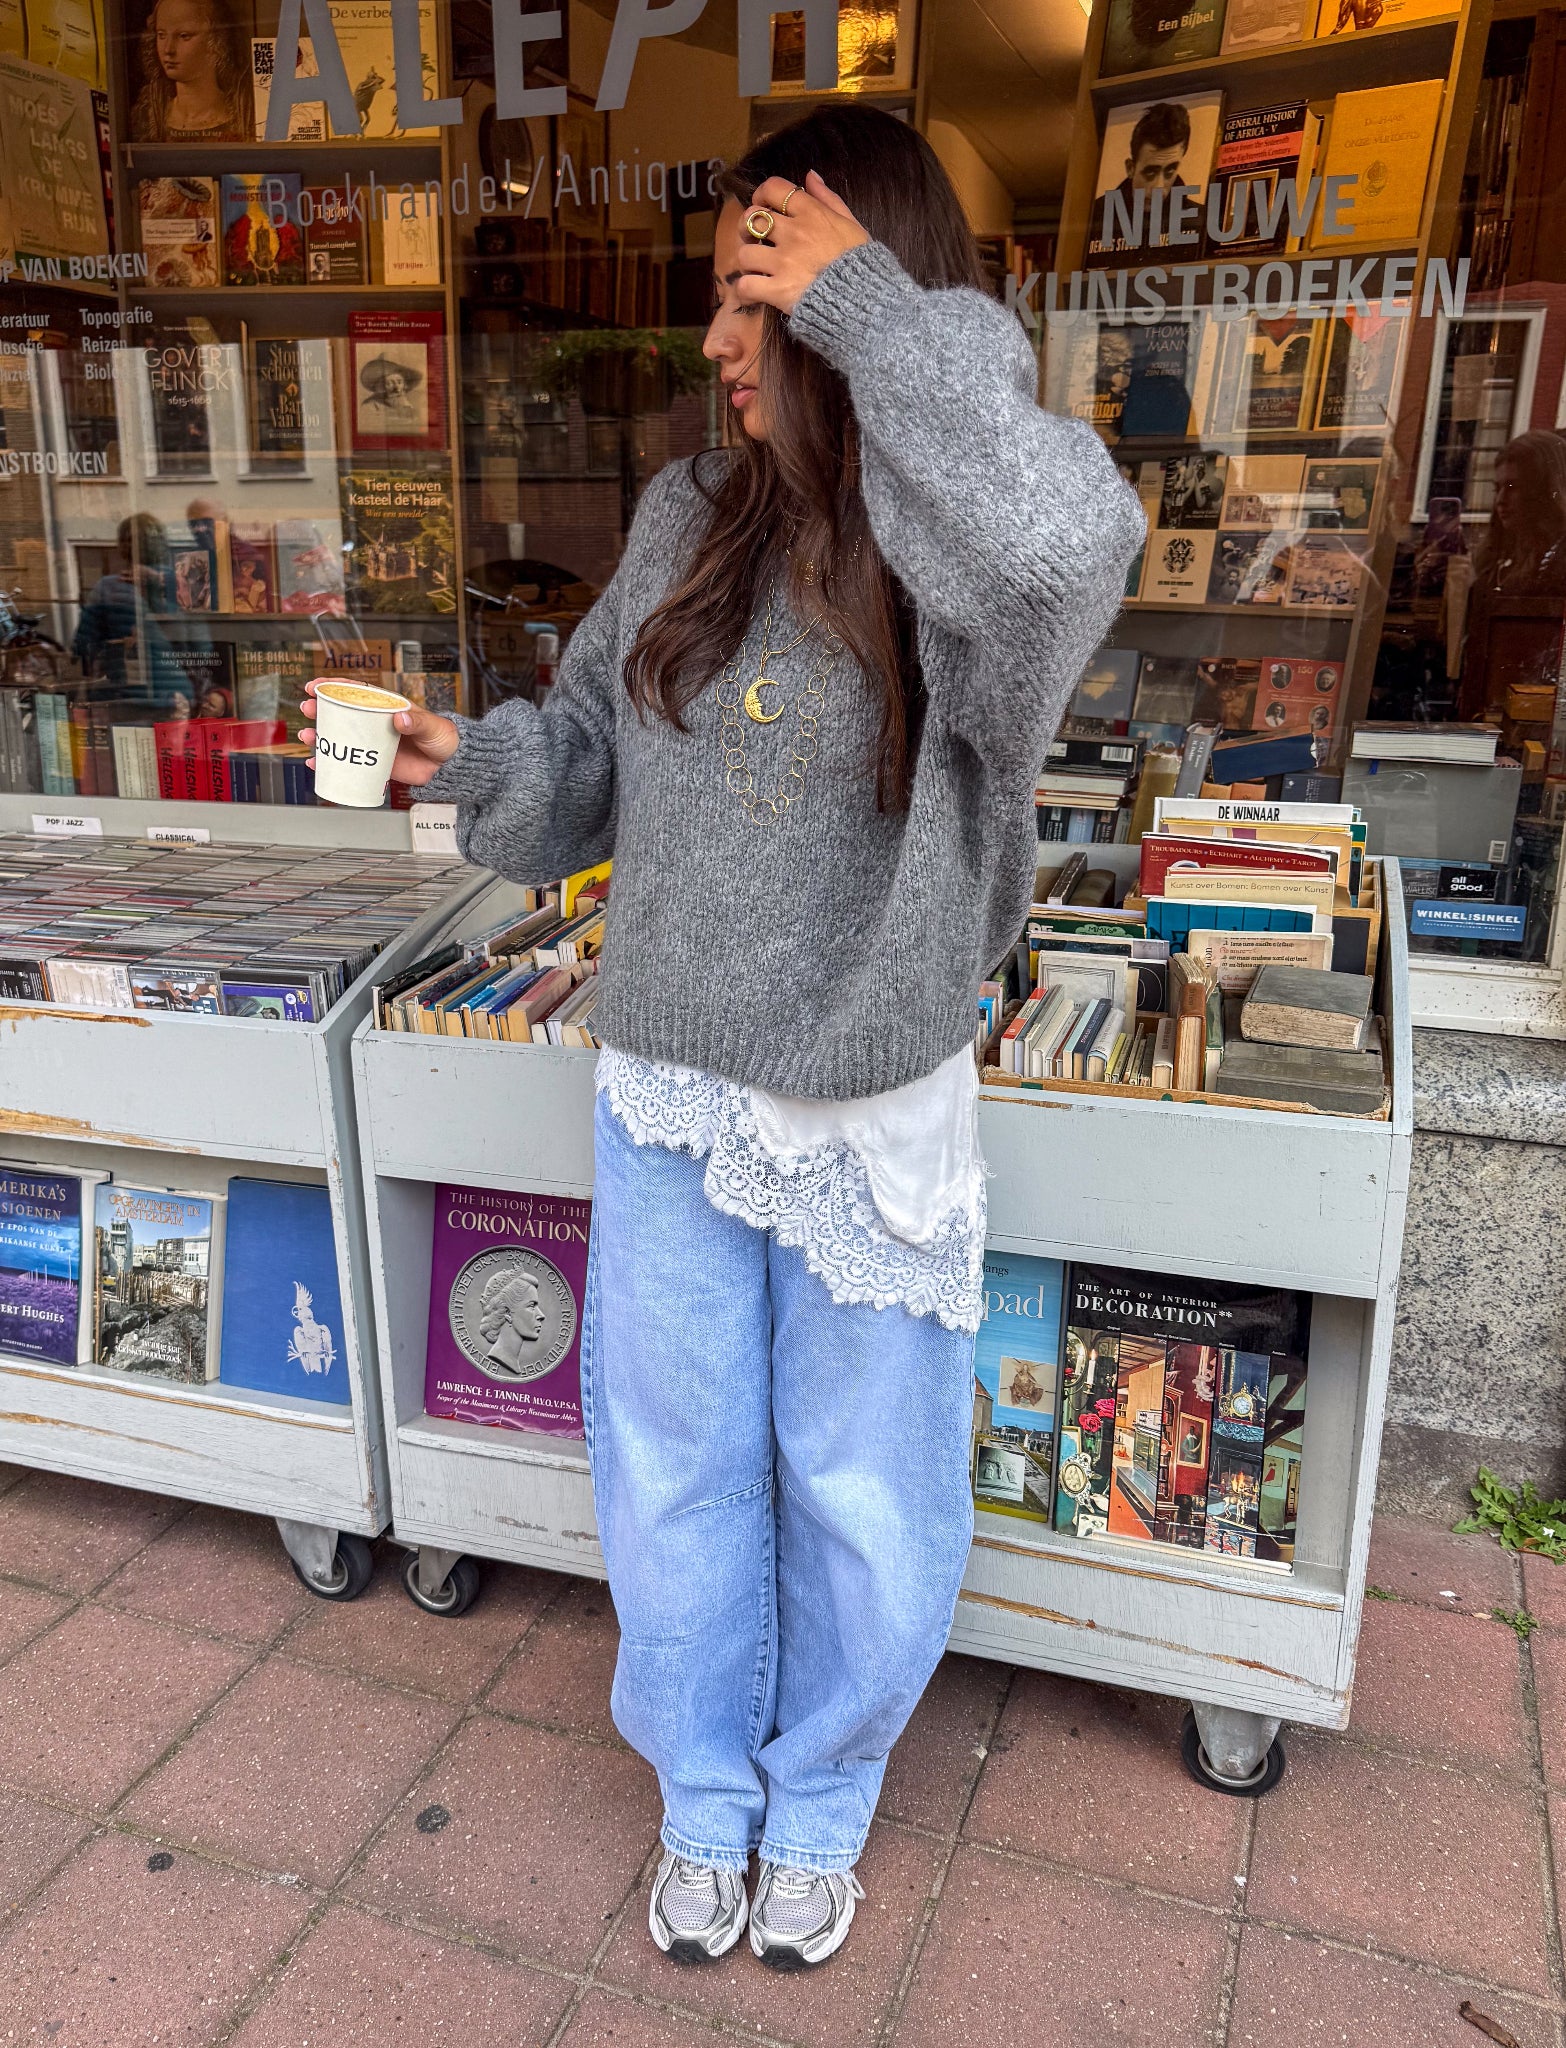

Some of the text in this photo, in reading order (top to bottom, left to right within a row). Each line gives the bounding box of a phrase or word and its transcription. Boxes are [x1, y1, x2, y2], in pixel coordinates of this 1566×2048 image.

[330, 6, 431, 19] De verbers
[1158, 9, 1215, 32] Een Bijbel
[254, 42, 273, 51] THE
[254, 51, 274, 59] BIG
[254, 59, 274, 67] FAT
[254, 67, 273, 75] ONE
[9, 95, 58, 124] MOES
[1226, 109, 1298, 130] GENERAL HISTORY
[1224, 131, 1236, 142] OF
[1236, 126, 1265, 139] AFRICA
[30, 127, 87, 160] LANGS
[1102, 174, 1359, 247] NIEUWE
[20, 257, 62, 282] VAN
[69, 252, 149, 280] BOEKEN
[1006, 257, 1471, 328] KUNSTBOEKEN
[79, 305, 153, 329] Topografie
[1143, 325, 1200, 339] THOMAS
[82, 336, 128, 353] Reizen
[1146, 340, 1191, 353] MANN
[143, 346, 236, 368] GOVERT
[151, 370, 236, 391] FLINCK
[365, 478, 442, 492] Tien eeuwen
[349, 493, 443, 506] Kasteel de Haar
[244, 651, 266, 663] THE
[323, 645, 382, 670] Artusi
[245, 663, 264, 675] THE
[1218, 805, 1280, 821] DE WINNAAR
[66, 818, 84, 826] JAZZ
[415, 822, 451, 830] ALL CDS
[155, 833, 197, 843] CLASSICAL
[1150, 844, 1318, 868] TROUBADOURS ECKHART ALCHEMY TAROT
[1170, 881, 1194, 890] Kunst
[1251, 883, 1281, 892] Bomen
[1283, 885, 1303, 893] over
[1304, 884, 1329, 894] Kunst
[1450, 883, 1483, 893] good
[1451, 876, 1467, 884] all
[1, 1202, 62, 1221] SIOENEN
[108, 1193, 201, 1217] OPGRAVINGEN IN
[450, 1192, 589, 1219] THE HISTORY OF THE
[115, 1206, 185, 1227] AMSTERDAM
[7, 1223, 28, 1232] EPOS
[30, 1226, 45, 1236] VAN
[447, 1209, 588, 1244] CORONATION
[983, 1262, 1009, 1277] langs
[982, 1284, 1044, 1323] pad
[1077, 1282, 1218, 1310] THE ART OF INTERIOR
[0, 1304, 65, 1324] ERT HUGHES
[436, 1380, 482, 1396] LAWRENCE
[485, 1388, 493, 1397] E.
[493, 1389, 531, 1404] TANNER
[436, 1393, 454, 1402] Keeper
[453, 1396, 461, 1404] of
